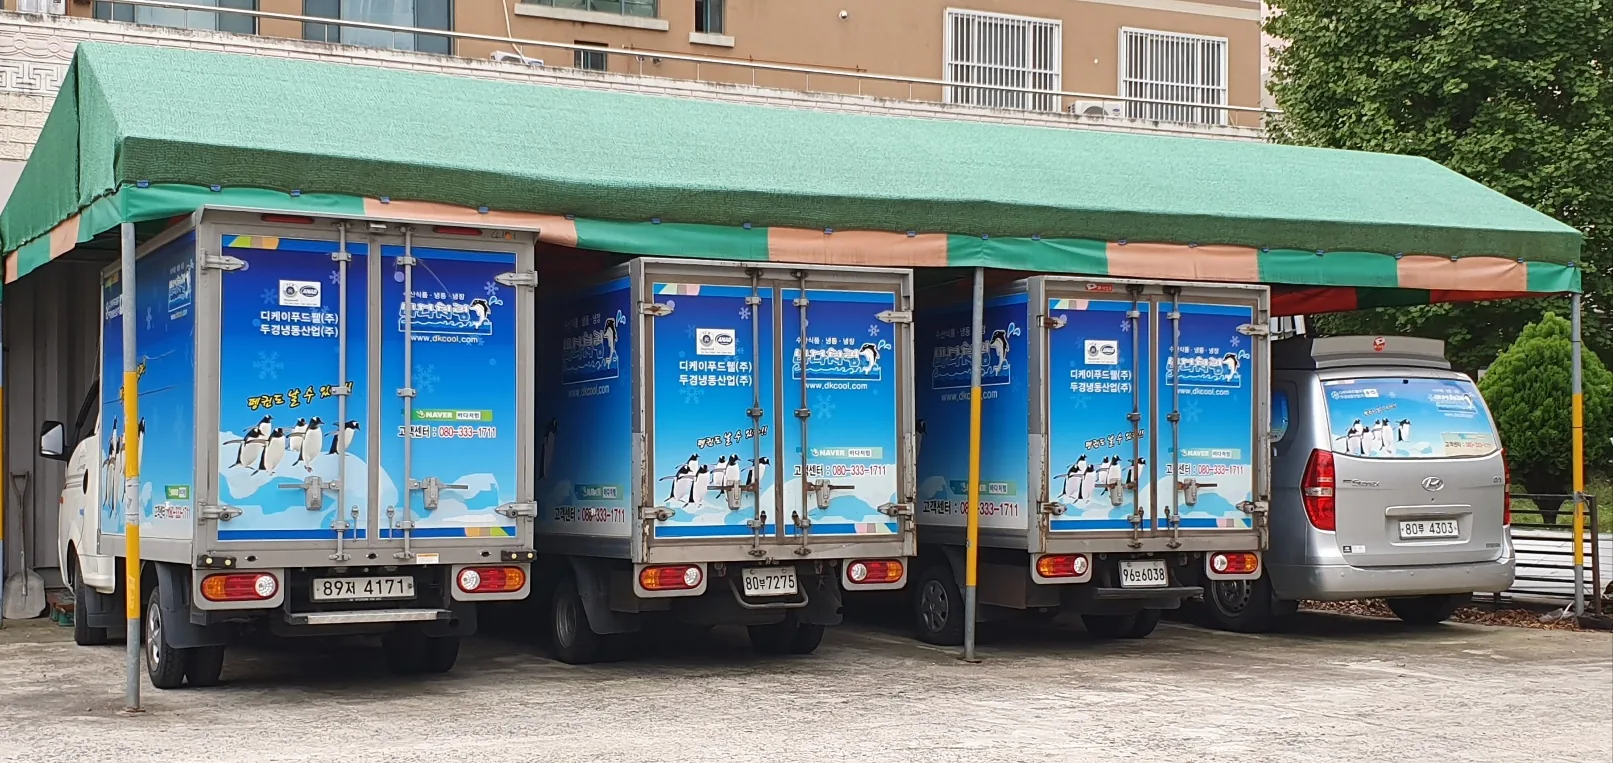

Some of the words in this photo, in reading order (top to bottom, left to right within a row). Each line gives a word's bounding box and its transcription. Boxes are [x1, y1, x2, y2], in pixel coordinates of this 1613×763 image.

[433, 292, 447, 300] 냉동
[452, 293, 465, 301] 냉장
[260, 310, 339, 325] 디케이푸드웰(주)
[259, 324, 339, 338] 두경냉동산업(주)
[410, 335, 479, 344] www.dkcool.com
[825, 337, 838, 345] 냉동
[843, 337, 855, 346] 냉장
[678, 360, 753, 373] 디케이푸드웰(주)
[678, 374, 753, 387] 두경냉동산업(주)
[1070, 369, 1132, 381] 디케이푸드웰(주)
[1069, 382, 1132, 393] 두경냉동산업(주)
[287, 388, 300, 409] 날
[303, 386, 316, 404] 수
[941, 390, 998, 402] www.dkc.com
[425, 411, 453, 419] NAVER
[439, 426, 497, 438] 080-333-1711
[723, 431, 733, 447] 날
[734, 429, 743, 443] 수
[1116, 432, 1123, 445] 수
[819, 449, 846, 457] NAVER
[832, 465, 887, 477] 080-333-1711
[1166, 463, 1191, 475] 고센터
[1198, 464, 1244, 475] 080-333-1711
[554, 507, 576, 522] 고객센터
[922, 500, 952, 515] 고객센터
[960, 501, 1019, 517] 08-333-1711
[1405, 523, 1425, 535] 80루
[1429, 522, 1454, 534] 4303
[1123, 567, 1165, 582] 96모6038
[323, 580, 356, 596] 89저
[363, 579, 404, 595] 4171
[745, 574, 795, 590] 80부7275
